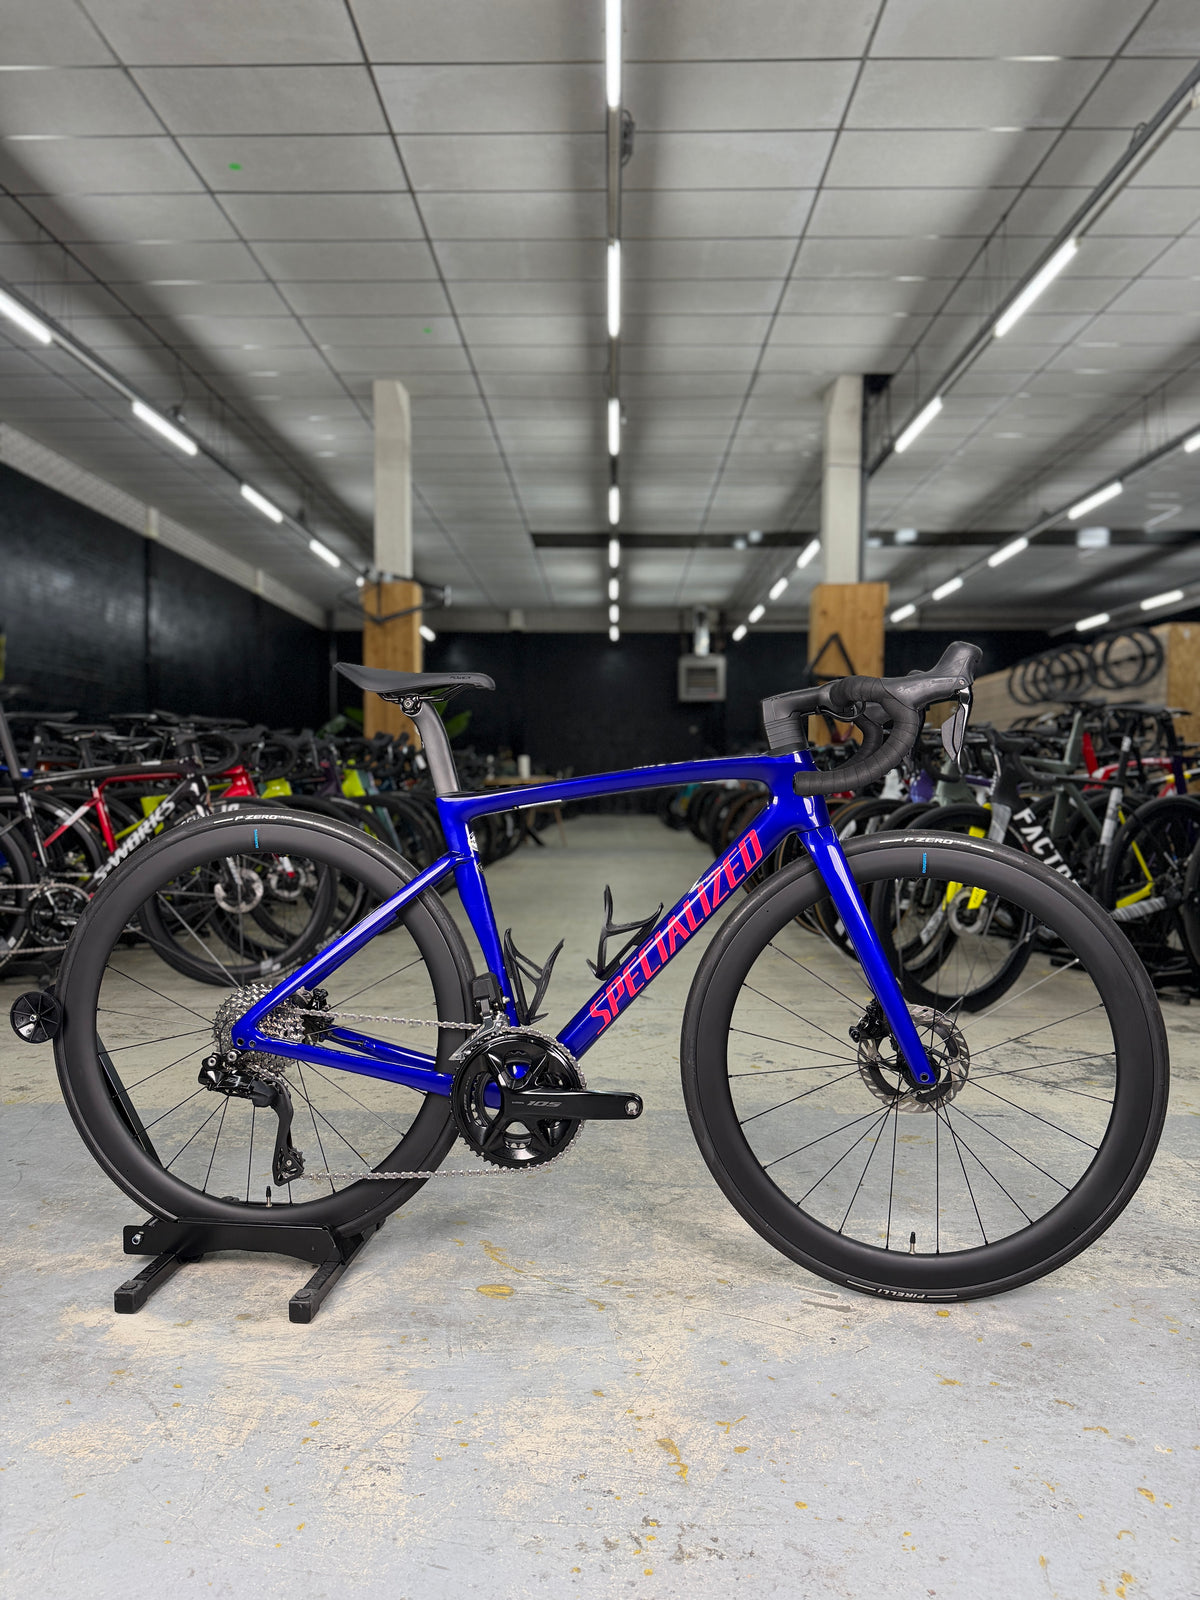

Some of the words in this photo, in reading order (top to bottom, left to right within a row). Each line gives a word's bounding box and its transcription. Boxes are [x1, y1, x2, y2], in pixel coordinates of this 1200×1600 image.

[93, 801, 176, 886] S-WORKS
[1012, 807, 1080, 888] FACTO
[590, 829, 763, 1035] SPECIALIZED
[527, 1100, 563, 1108] 105
[877, 1288, 926, 1299] PIRELLI
